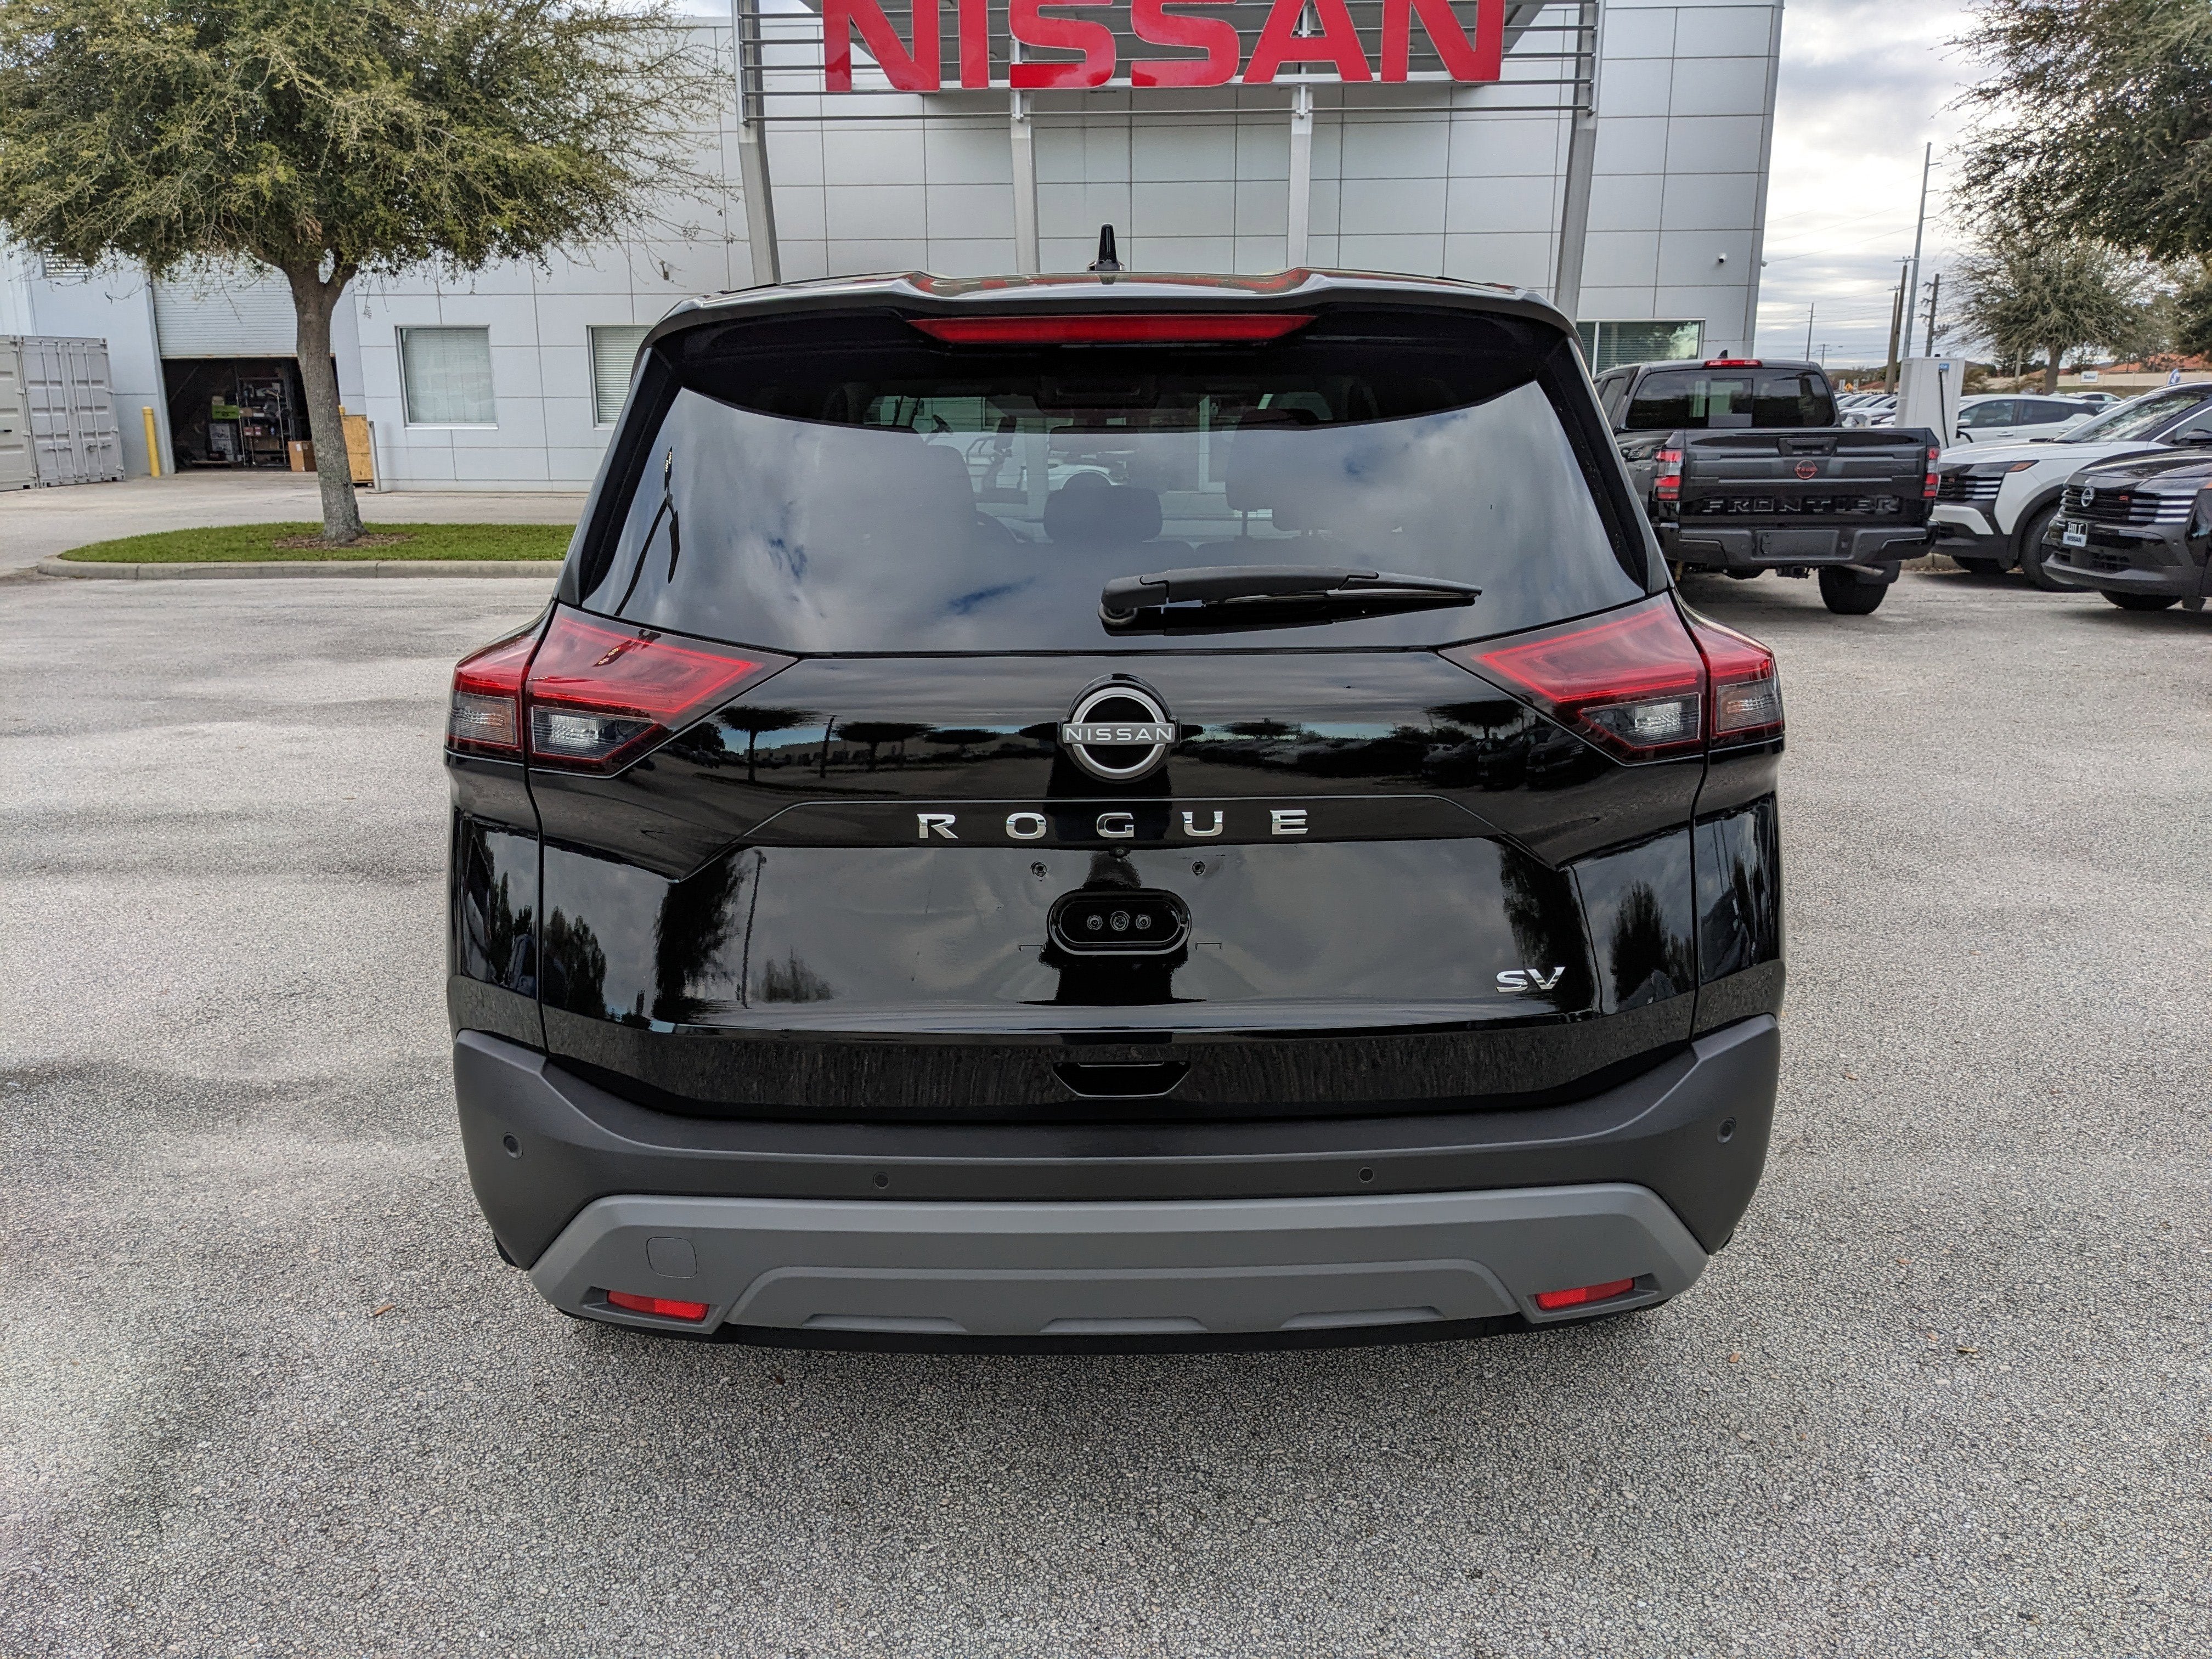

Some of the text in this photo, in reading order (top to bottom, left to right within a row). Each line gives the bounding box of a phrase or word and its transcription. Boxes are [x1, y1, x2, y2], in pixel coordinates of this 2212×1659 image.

[822, 0, 1505, 92] NISSAN
[1066, 727, 1172, 741] NISSAN
[917, 810, 1308, 839] ROGUE
[1495, 966, 1566, 993] SV
